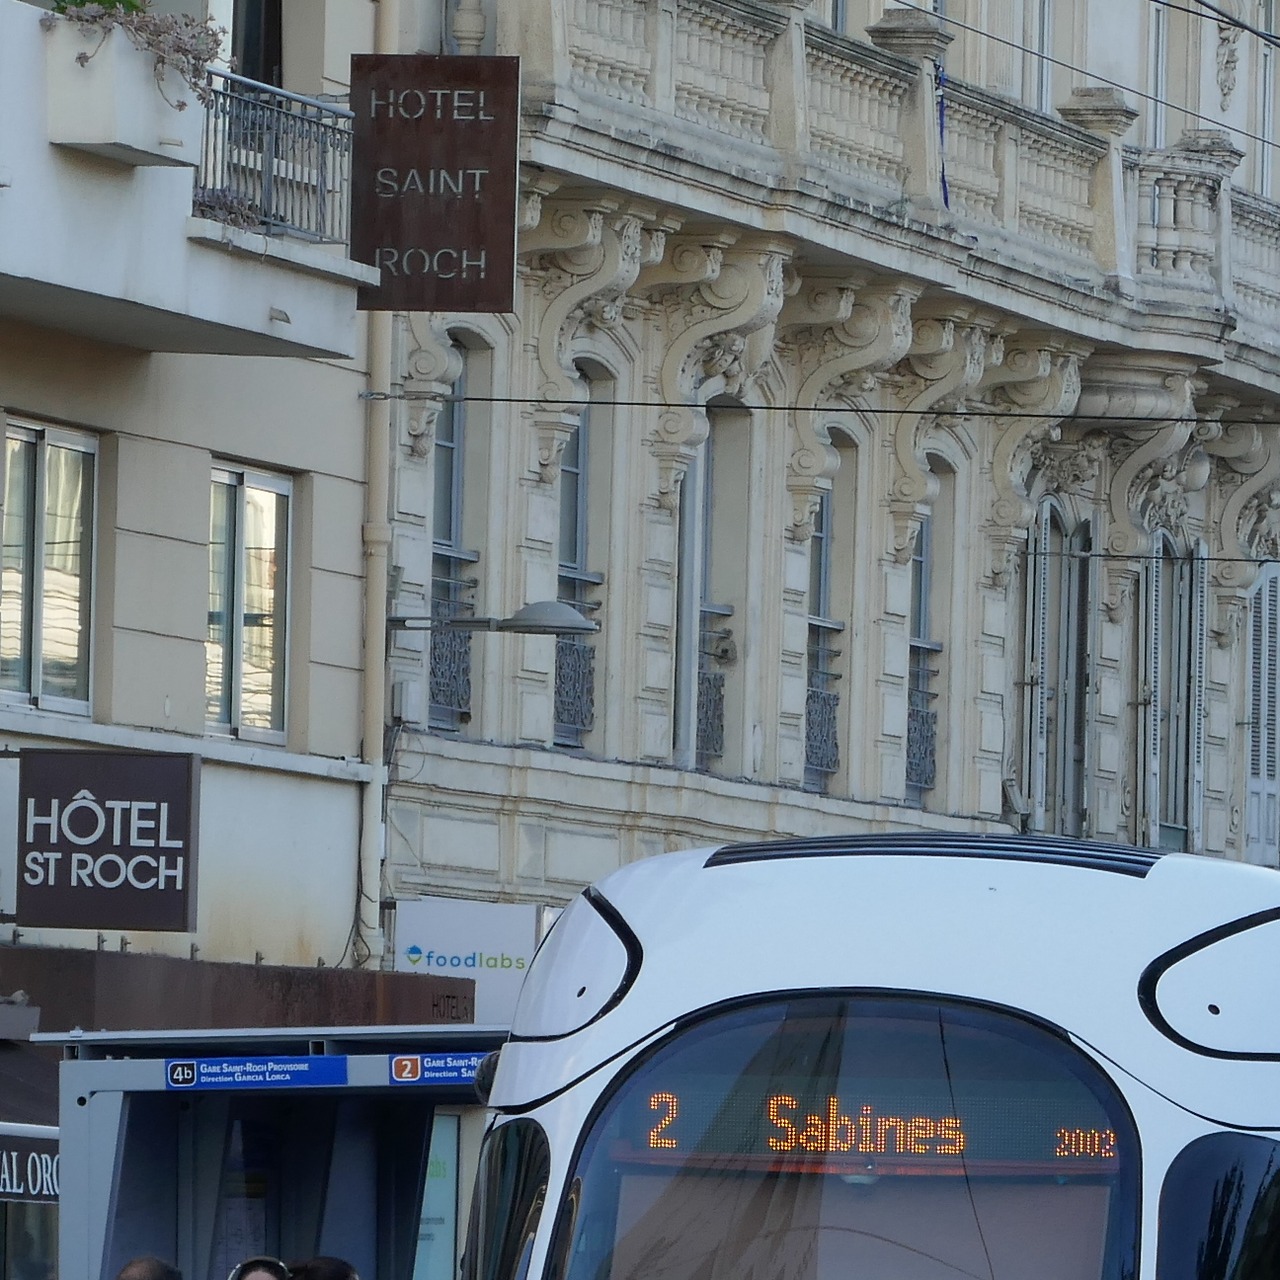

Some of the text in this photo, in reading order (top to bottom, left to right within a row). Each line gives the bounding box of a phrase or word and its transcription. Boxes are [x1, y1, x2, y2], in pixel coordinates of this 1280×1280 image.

[369, 88, 496, 121] HOTEL
[375, 167, 490, 199] SAINT
[374, 247, 487, 280] ROCH
[26, 789, 183, 848] HÔTEL
[24, 851, 183, 890] ST ROCH
[426, 950, 526, 970] foodlabs
[172, 1066, 193, 1082] 4b
[200, 1063, 221, 1073] GARE
[222, 1062, 267, 1072] SAINT-ROCH
[402, 1060, 412, 1077] 2
[424, 1058, 445, 1067] GARE
[424, 1070, 458, 1078] Direction
[201, 1071, 291, 1083] Direction GARCIA LORCA
[648, 1092, 1116, 1158] 2 Sabines 2002
[0, 1150, 24, 1194] AL
